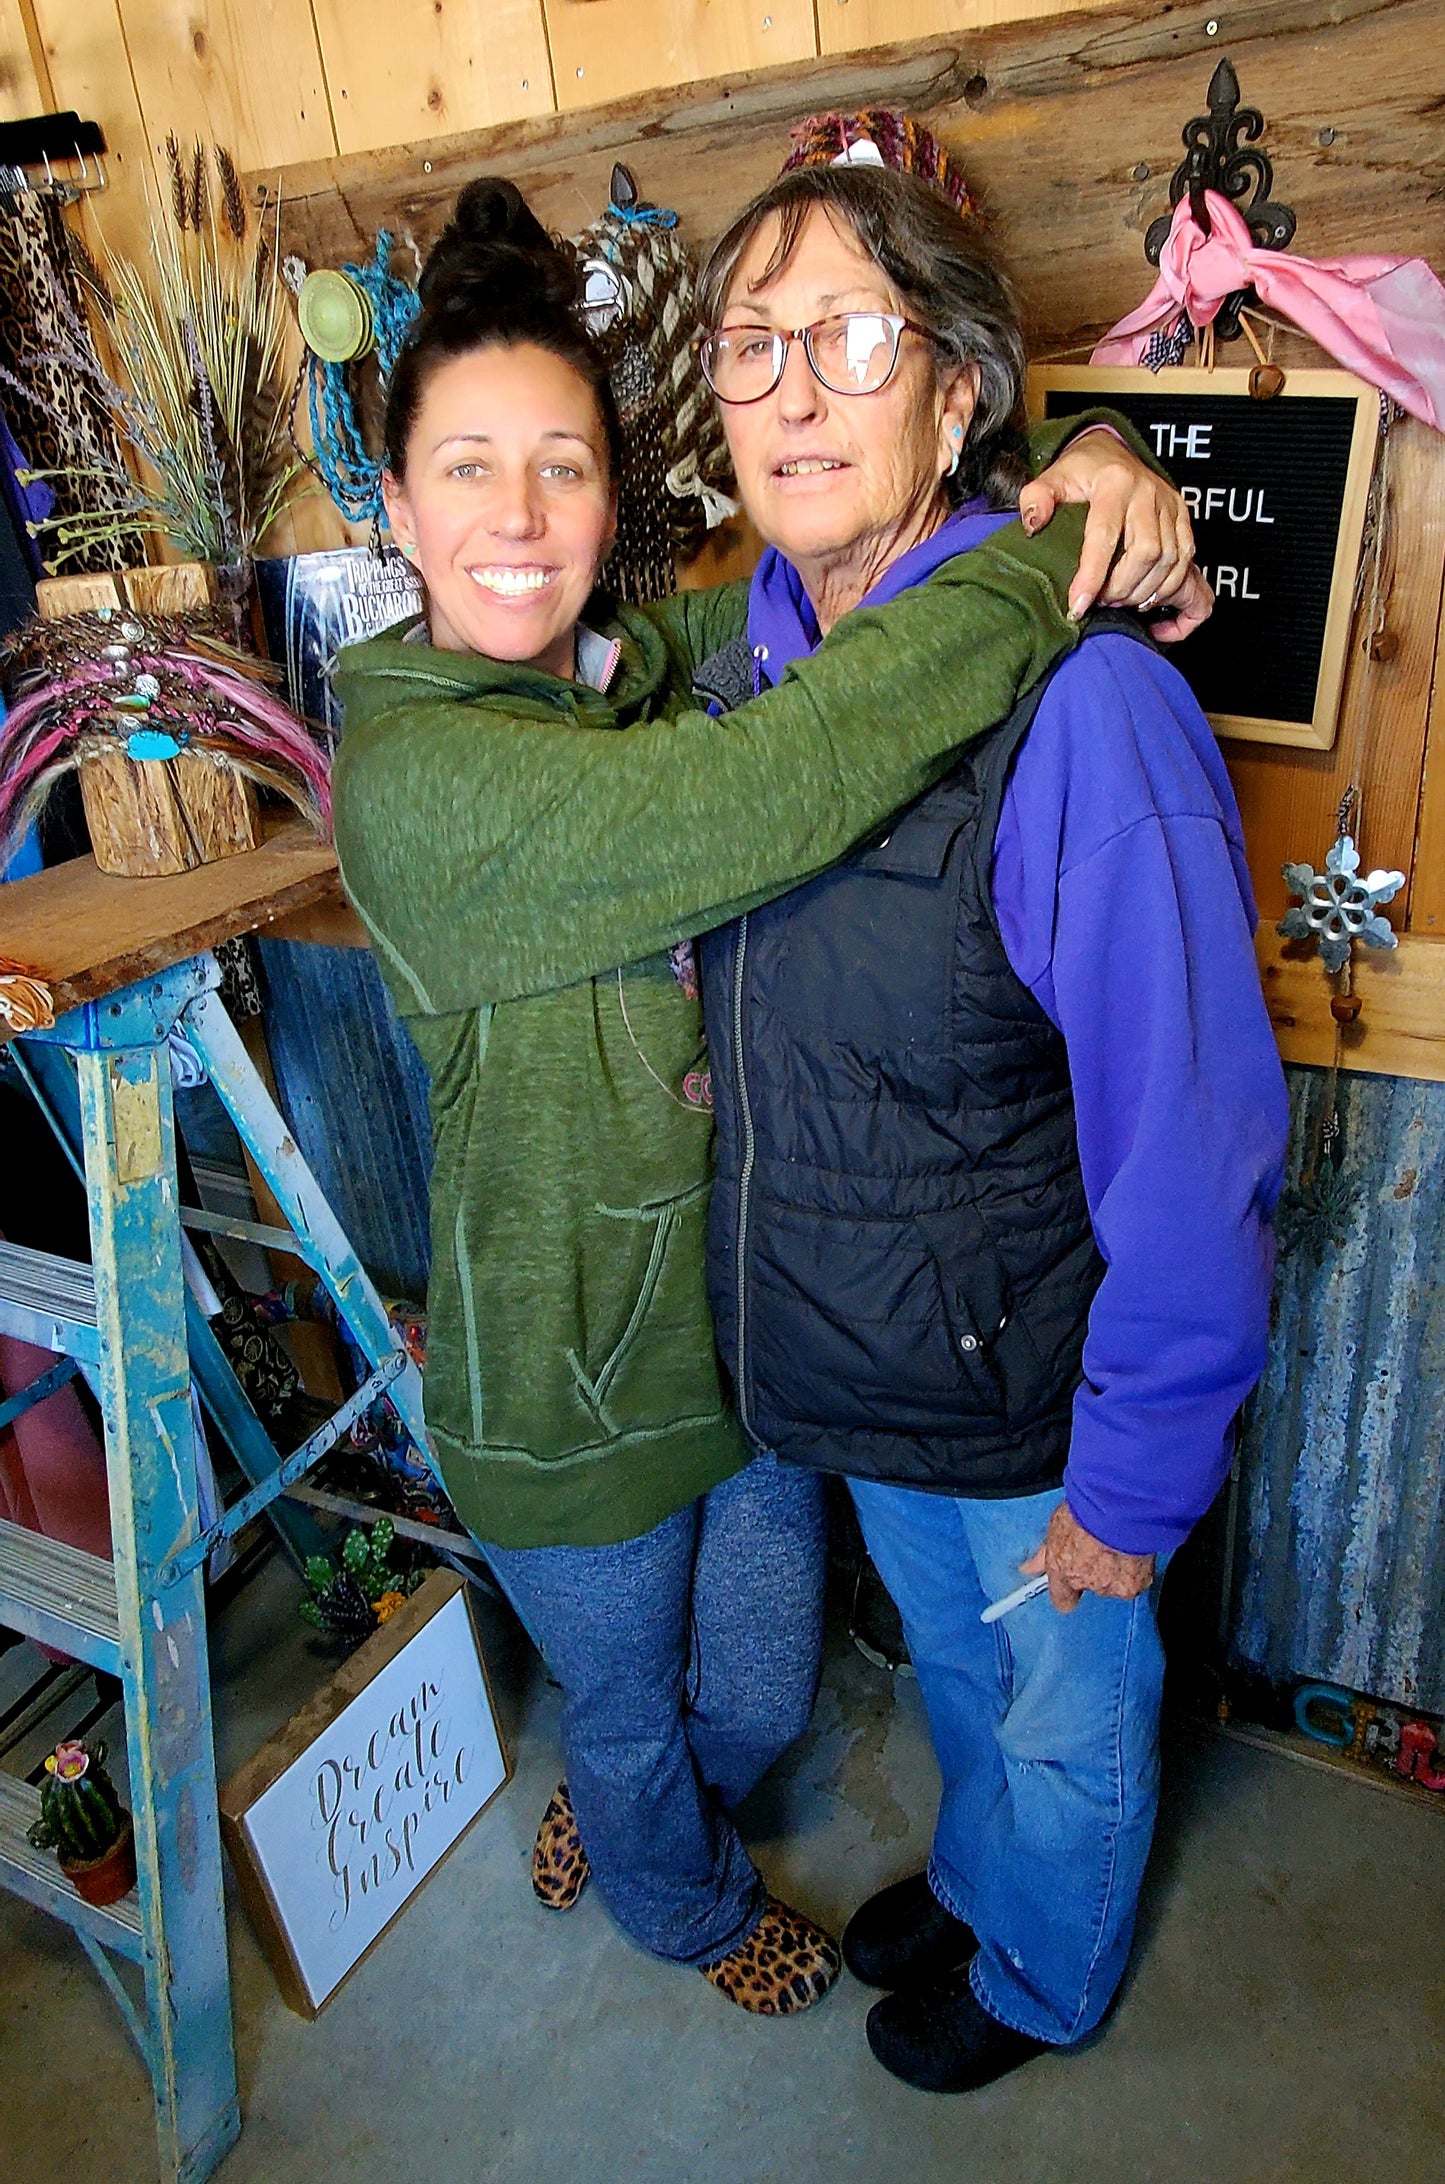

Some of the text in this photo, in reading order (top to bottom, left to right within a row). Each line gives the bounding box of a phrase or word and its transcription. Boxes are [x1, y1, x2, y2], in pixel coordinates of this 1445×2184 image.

[1149, 423, 1213, 459] THE
[342, 556, 407, 593] TRAPPINGS
[358, 582, 368, 596] OF
[368, 580, 382, 595] THE
[382, 577, 403, 593] GREAT
[310, 1667, 446, 1831] Dream
[317, 1697, 453, 1878] Create
[329, 1743, 476, 1932] Inspire
